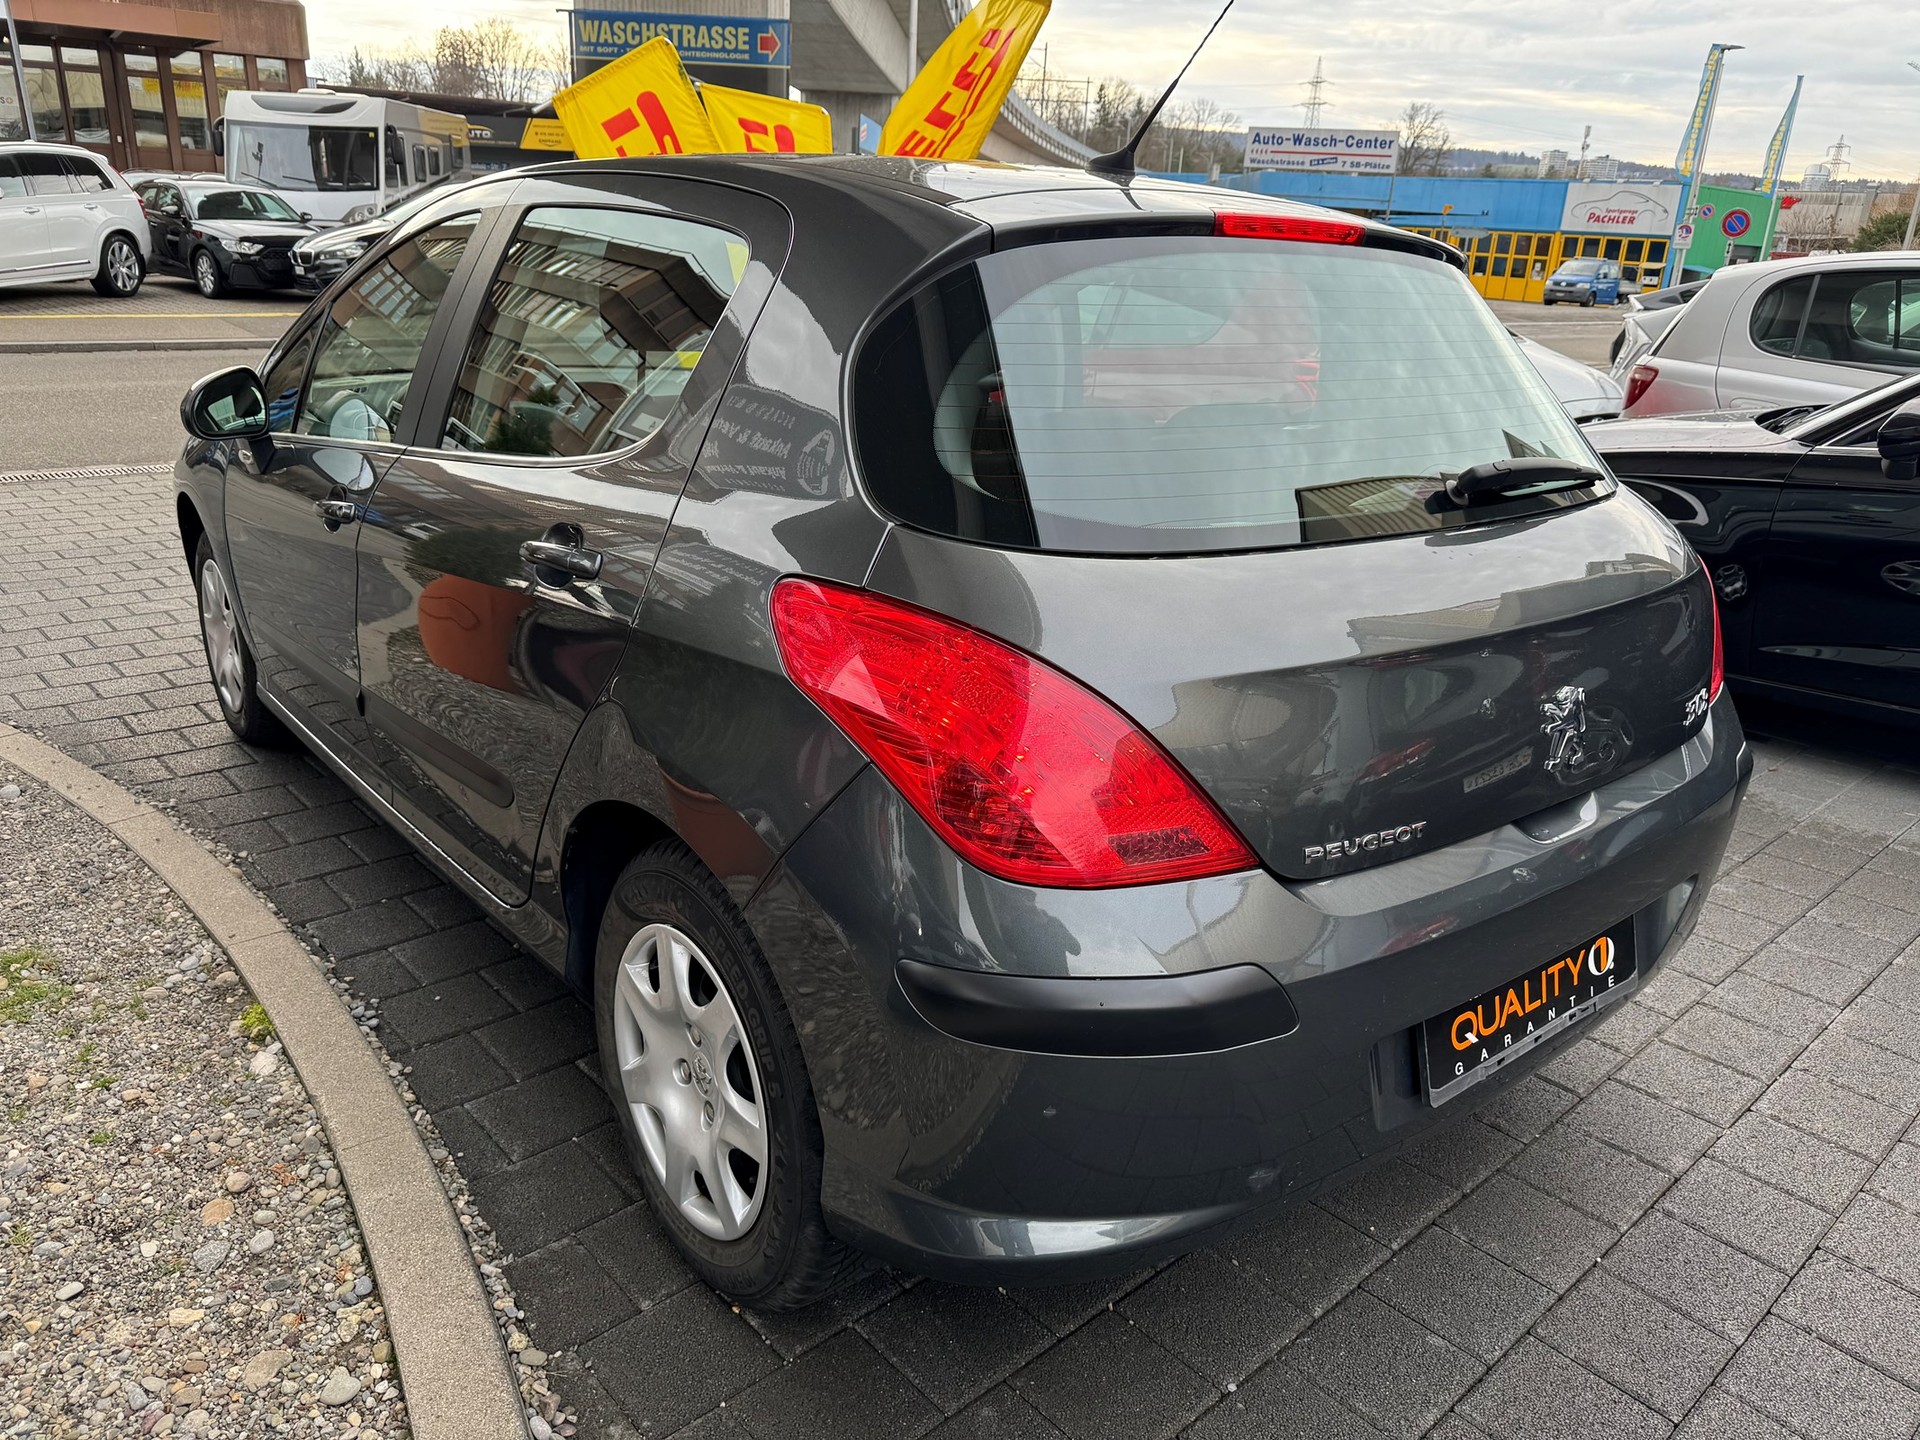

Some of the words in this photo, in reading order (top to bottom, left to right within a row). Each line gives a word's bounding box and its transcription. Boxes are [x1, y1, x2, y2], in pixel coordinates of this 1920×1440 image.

[578, 20, 750, 50] WASCHSTRASSE
[597, 46, 619, 54] SOFT
[1252, 132, 1394, 149] Auto-Wasch-Center
[1250, 157, 1306, 166] Waschstrasse
[1586, 213, 1636, 225] PACHLER
[1303, 821, 1428, 865] PEUGEOT
[1454, 974, 1615, 1075] GARANTIE
